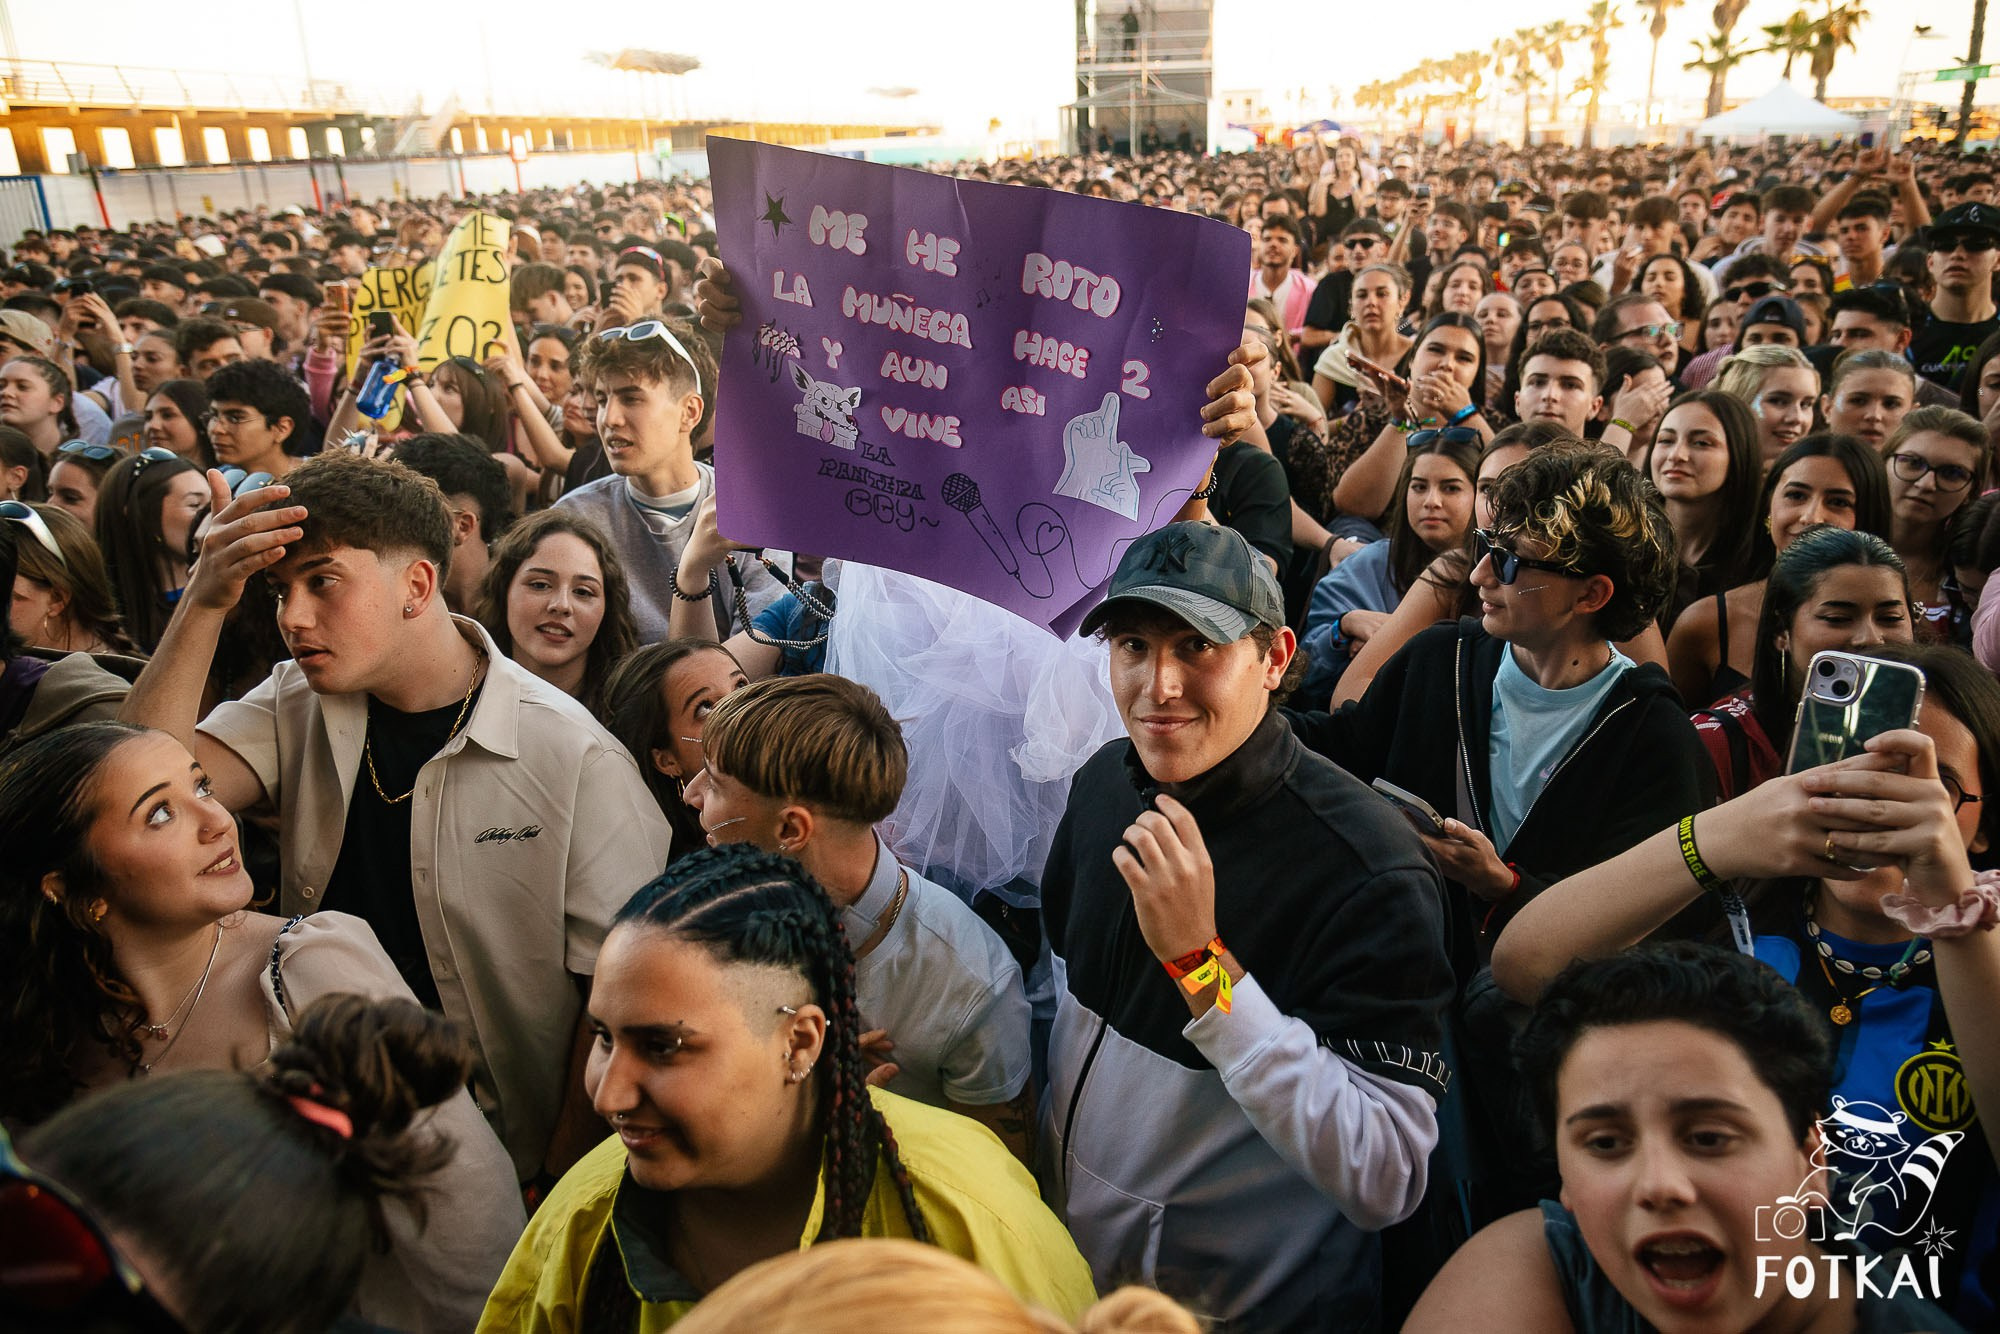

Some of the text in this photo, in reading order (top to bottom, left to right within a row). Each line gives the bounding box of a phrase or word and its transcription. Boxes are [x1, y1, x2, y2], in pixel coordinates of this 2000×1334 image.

[808, 203, 1121, 318] ME HE ROTO
[773, 269, 1151, 400] LA MUÑECA HACE 2
[821, 336, 1046, 417] Y AUN ASI
[880, 405, 962, 449] VINE
[861, 441, 896, 467] LA
[818, 458, 926, 500] PANTERA
[1682, 841, 1708, 878] STAGE
